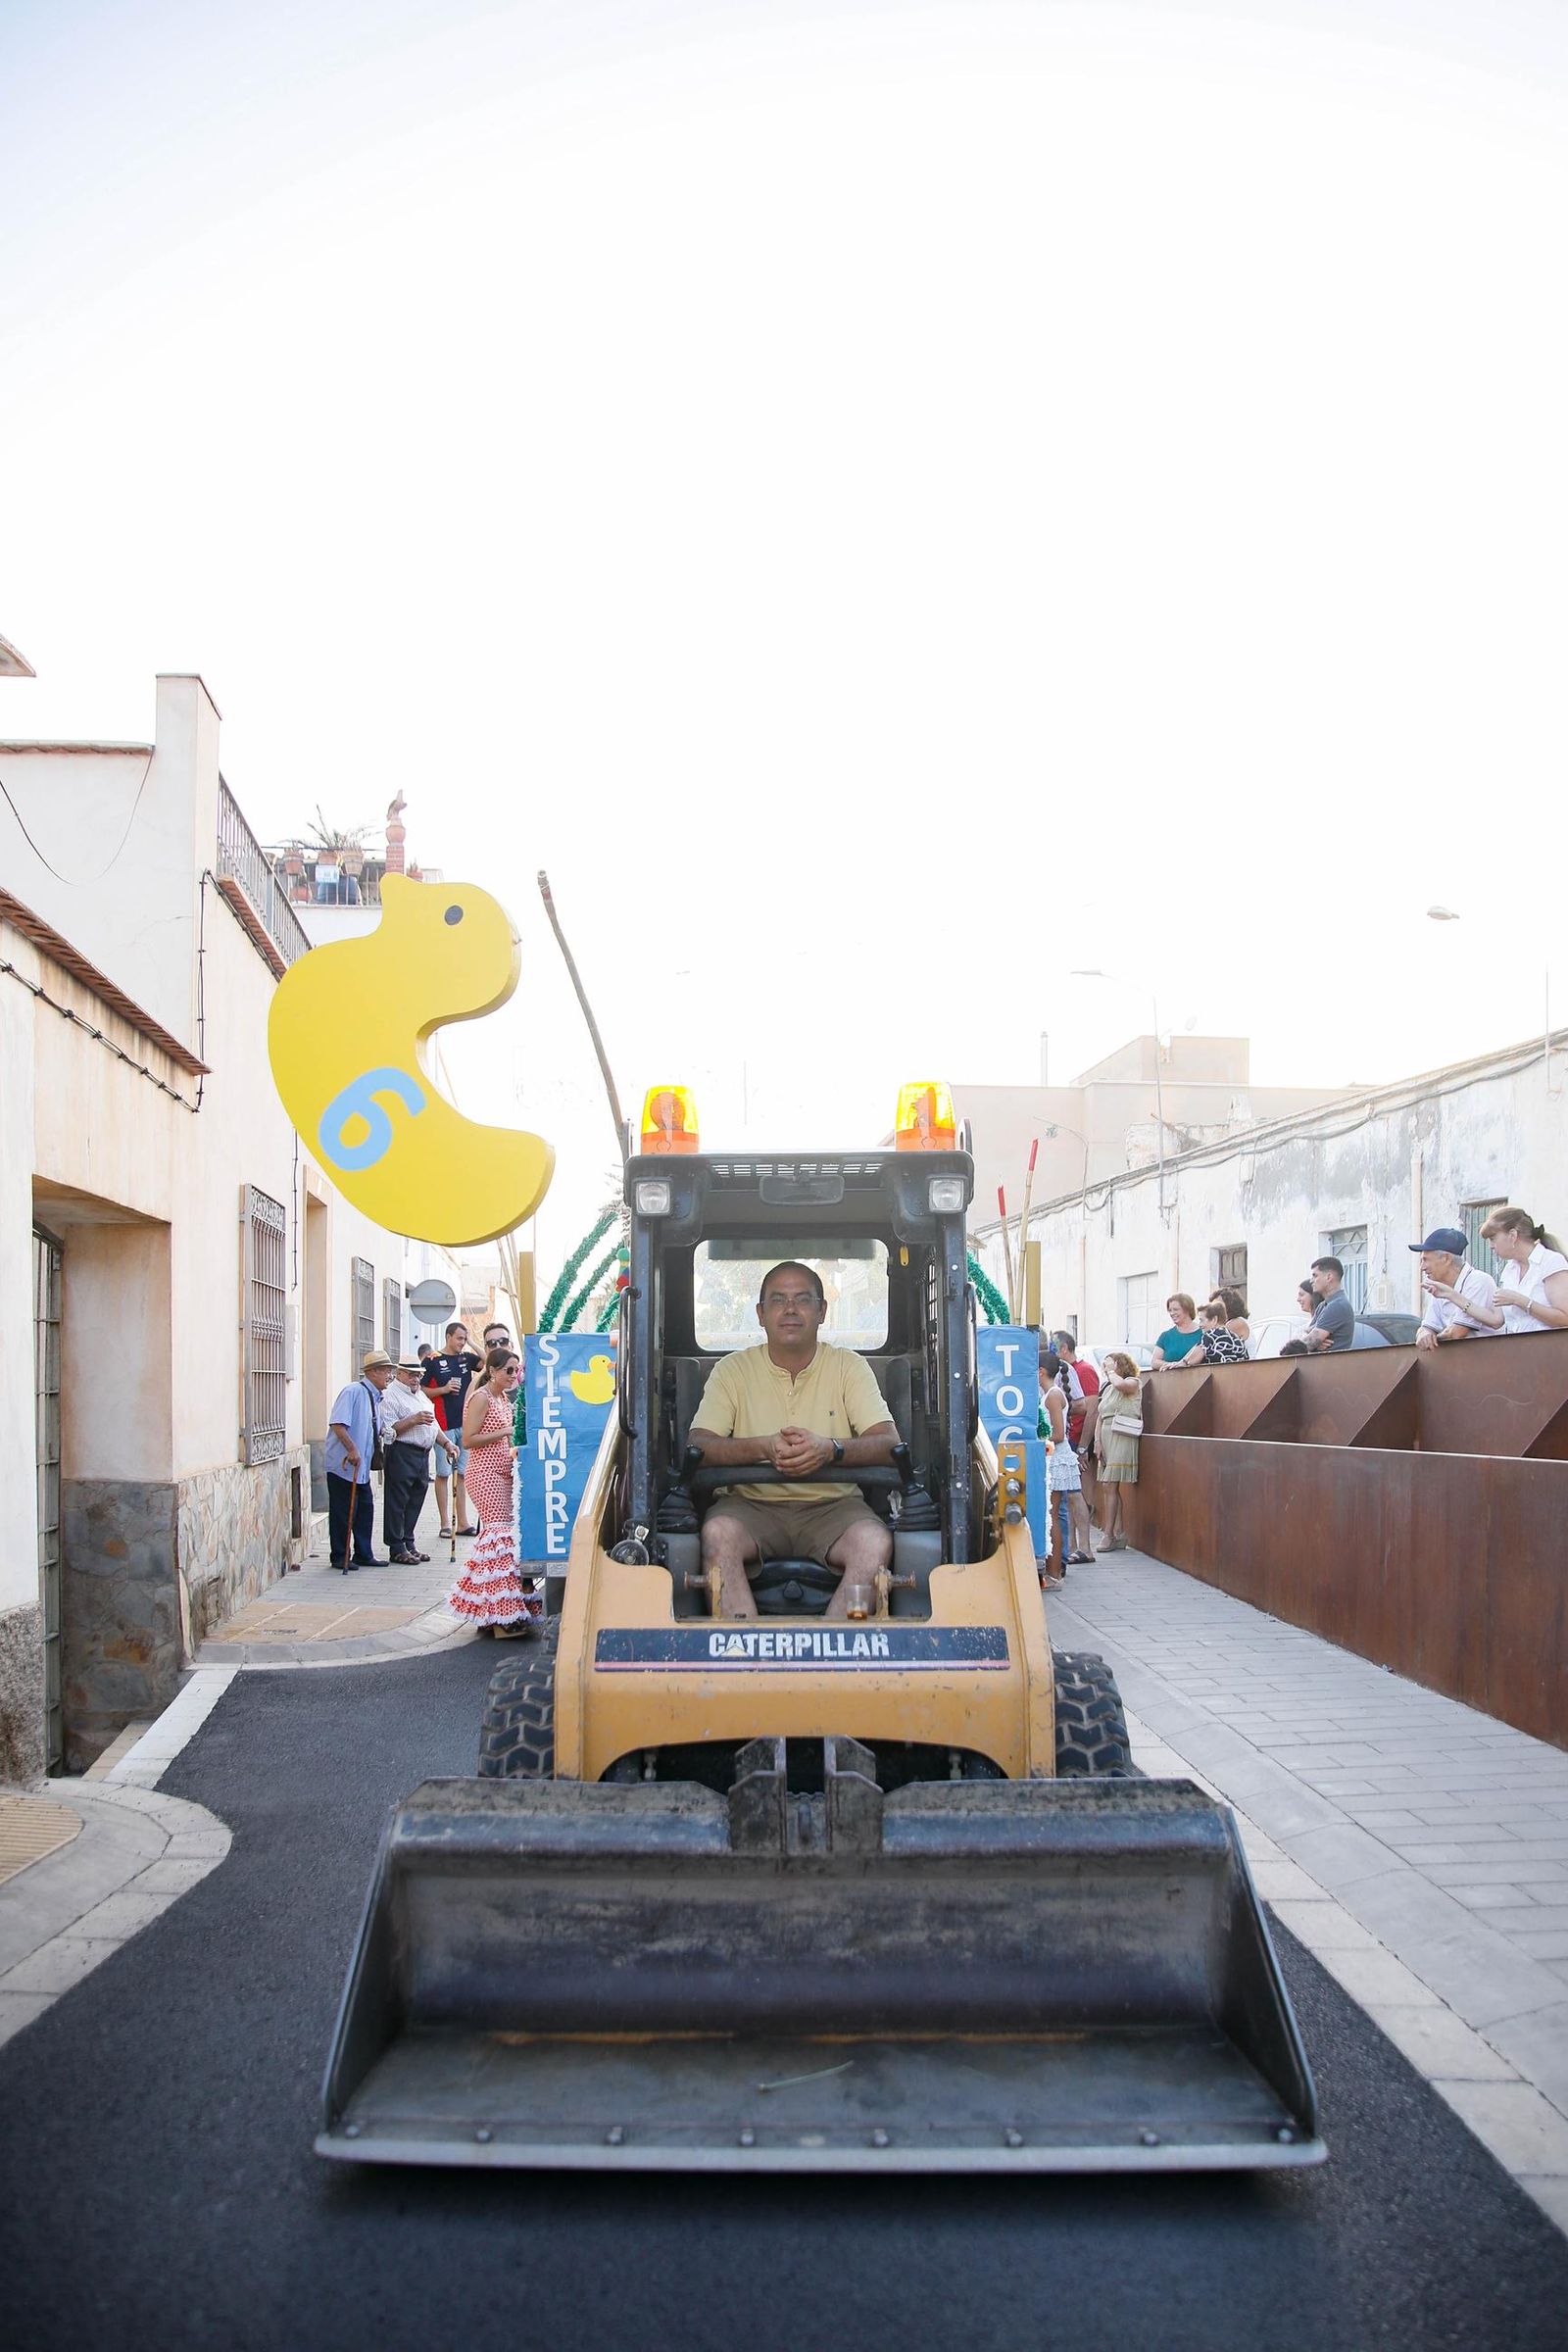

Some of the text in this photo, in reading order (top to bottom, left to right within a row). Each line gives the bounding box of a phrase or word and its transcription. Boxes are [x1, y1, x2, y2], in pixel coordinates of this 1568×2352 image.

[318, 1066, 427, 1171] 6
[538, 1335, 569, 1554] SIEMPRE
[709, 1633, 890, 1657] CATERPILLAR
